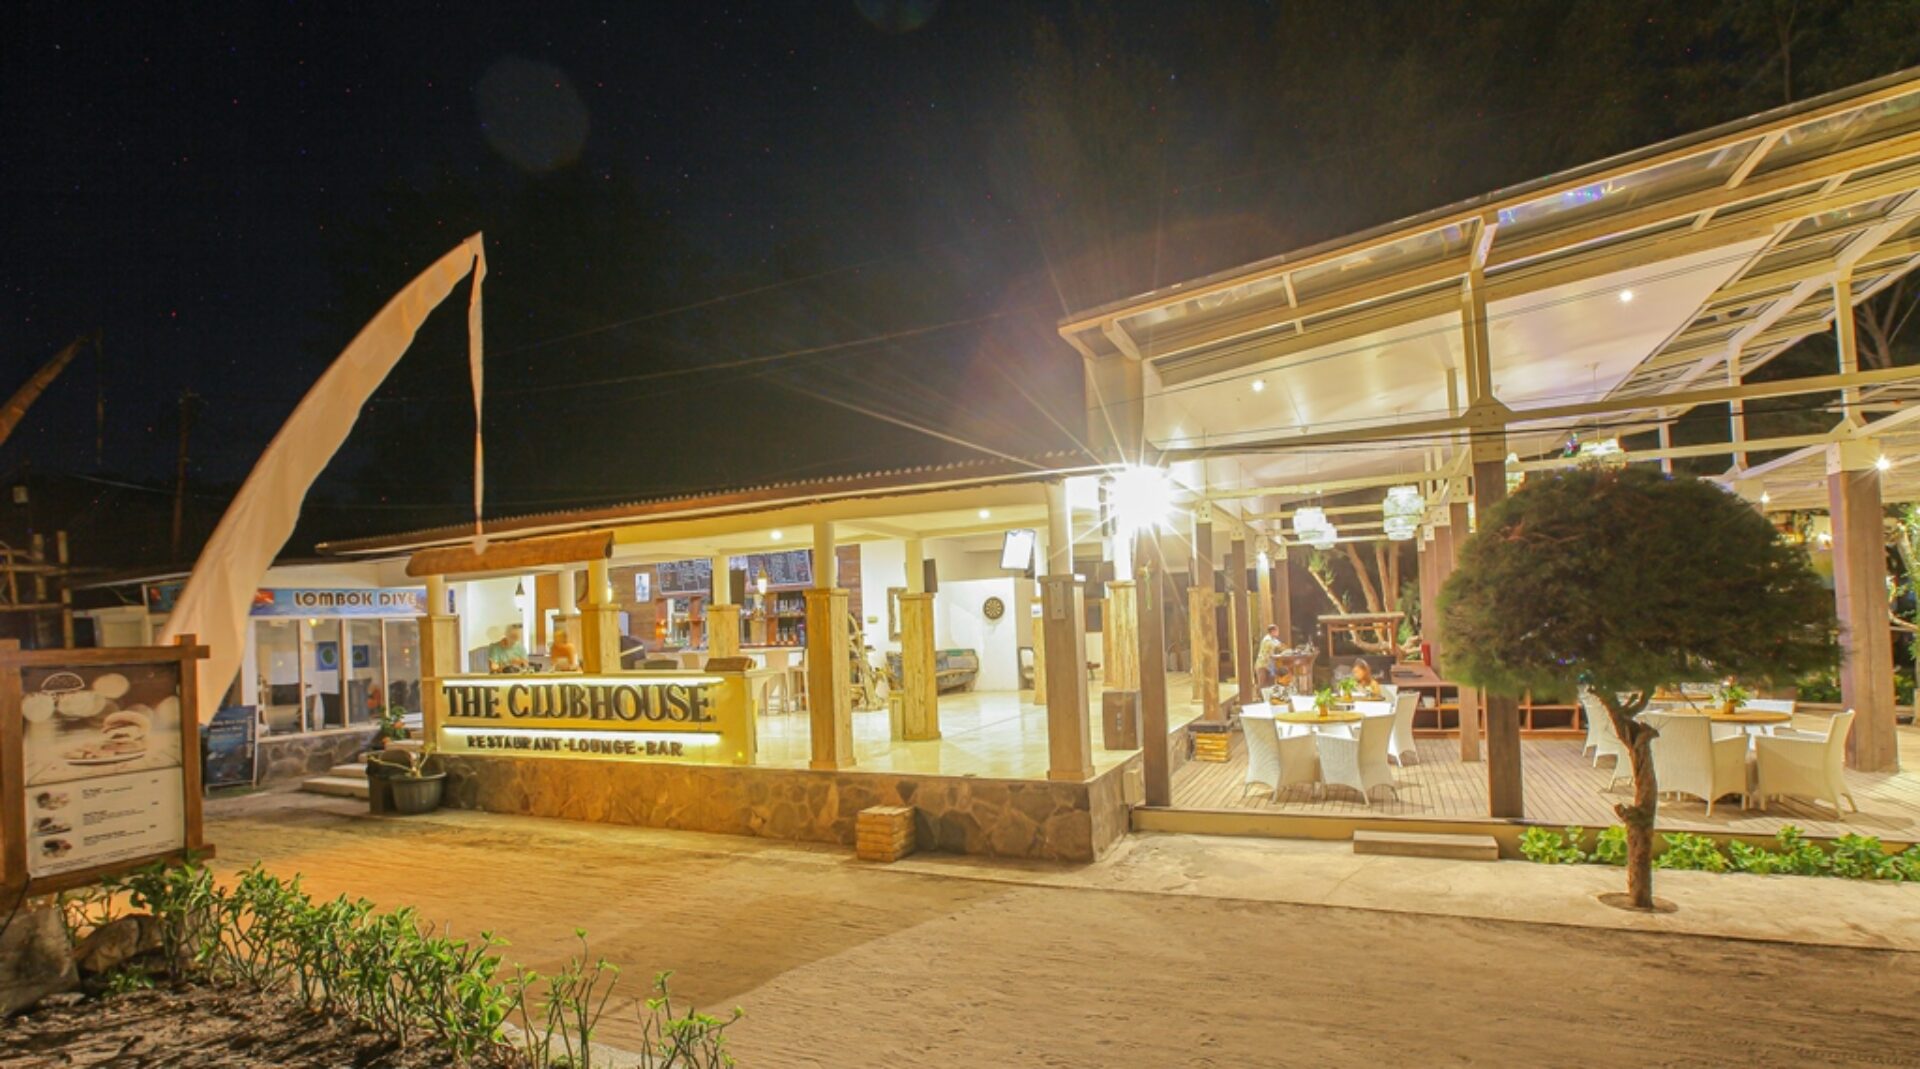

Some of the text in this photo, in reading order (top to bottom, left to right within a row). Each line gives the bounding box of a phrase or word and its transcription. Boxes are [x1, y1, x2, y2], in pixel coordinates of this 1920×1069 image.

[294, 591, 416, 607] LOMBOK DIVE
[442, 683, 713, 723] THE CLUBHOUSE
